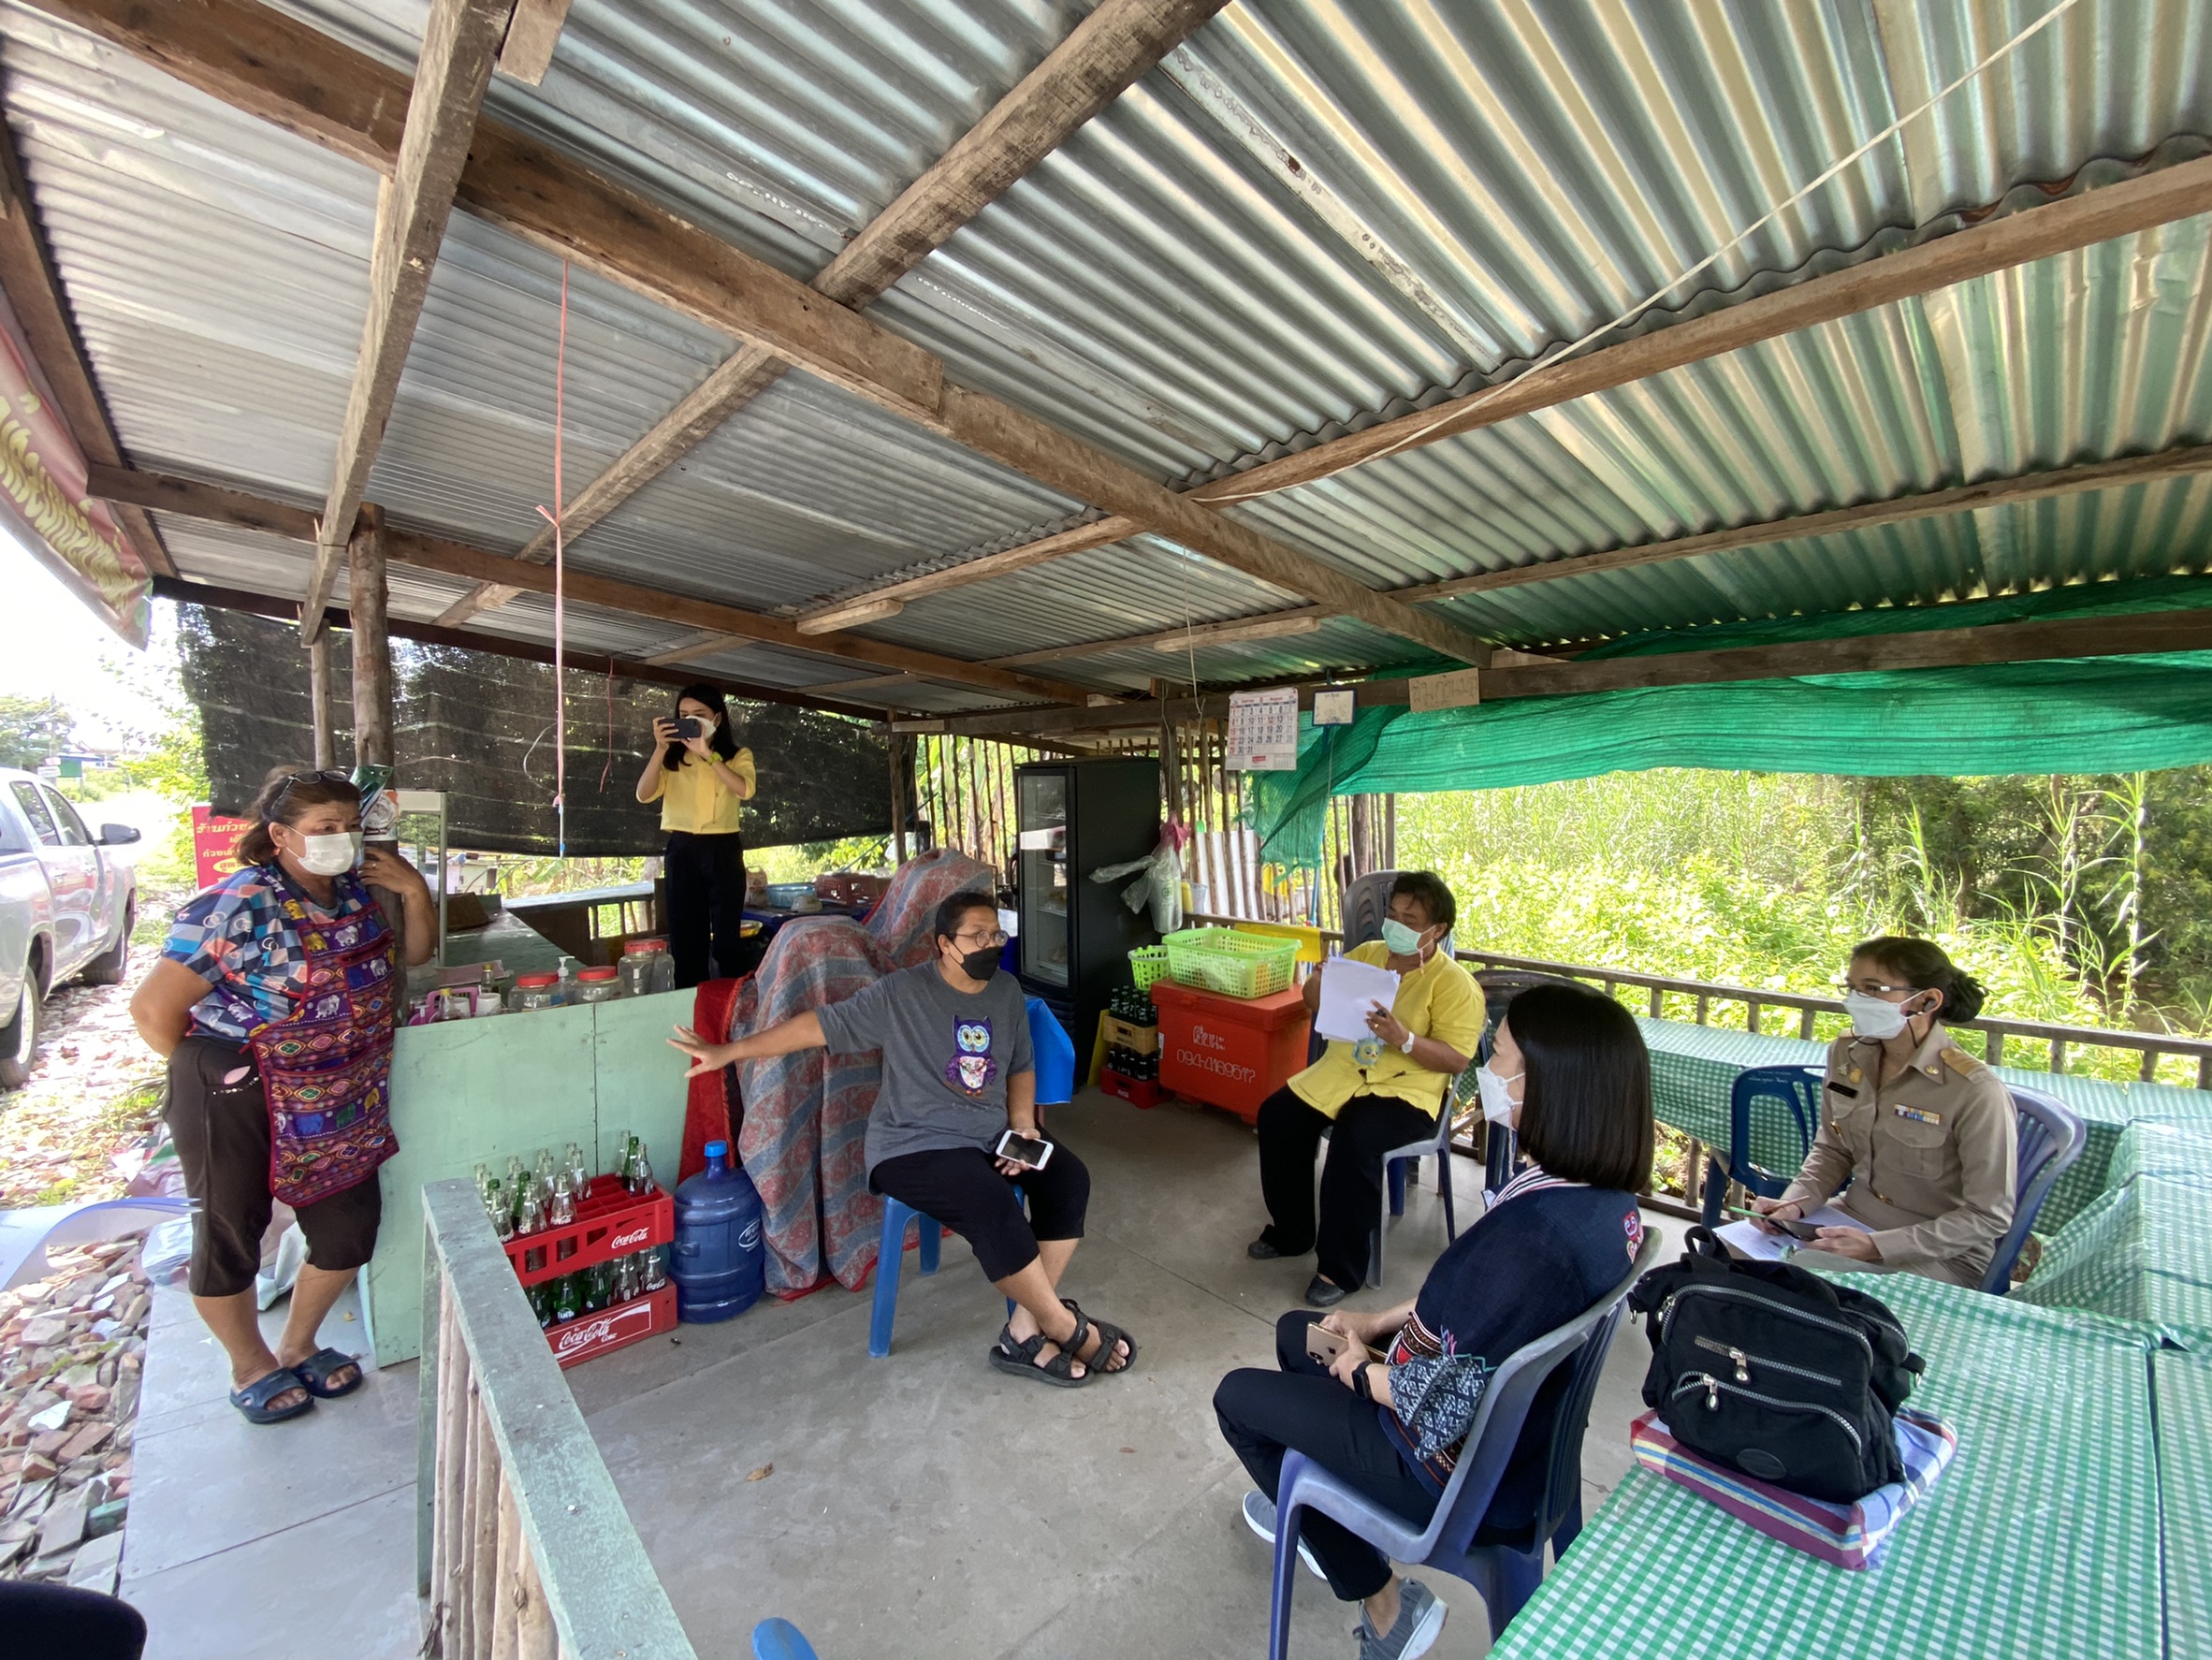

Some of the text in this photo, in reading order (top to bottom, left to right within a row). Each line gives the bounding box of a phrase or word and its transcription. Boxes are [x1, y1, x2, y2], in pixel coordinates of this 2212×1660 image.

[1276, 715, 1283, 723] 13
[1230, 727, 1236, 735] 15
[1247, 726, 1254, 735] 17
[1230, 737, 1235, 746] 22
[1238, 736, 1244, 745] 23
[611, 1227, 649, 1248] Coca-Cola
[559, 1318, 611, 1350] Coca-Cola
